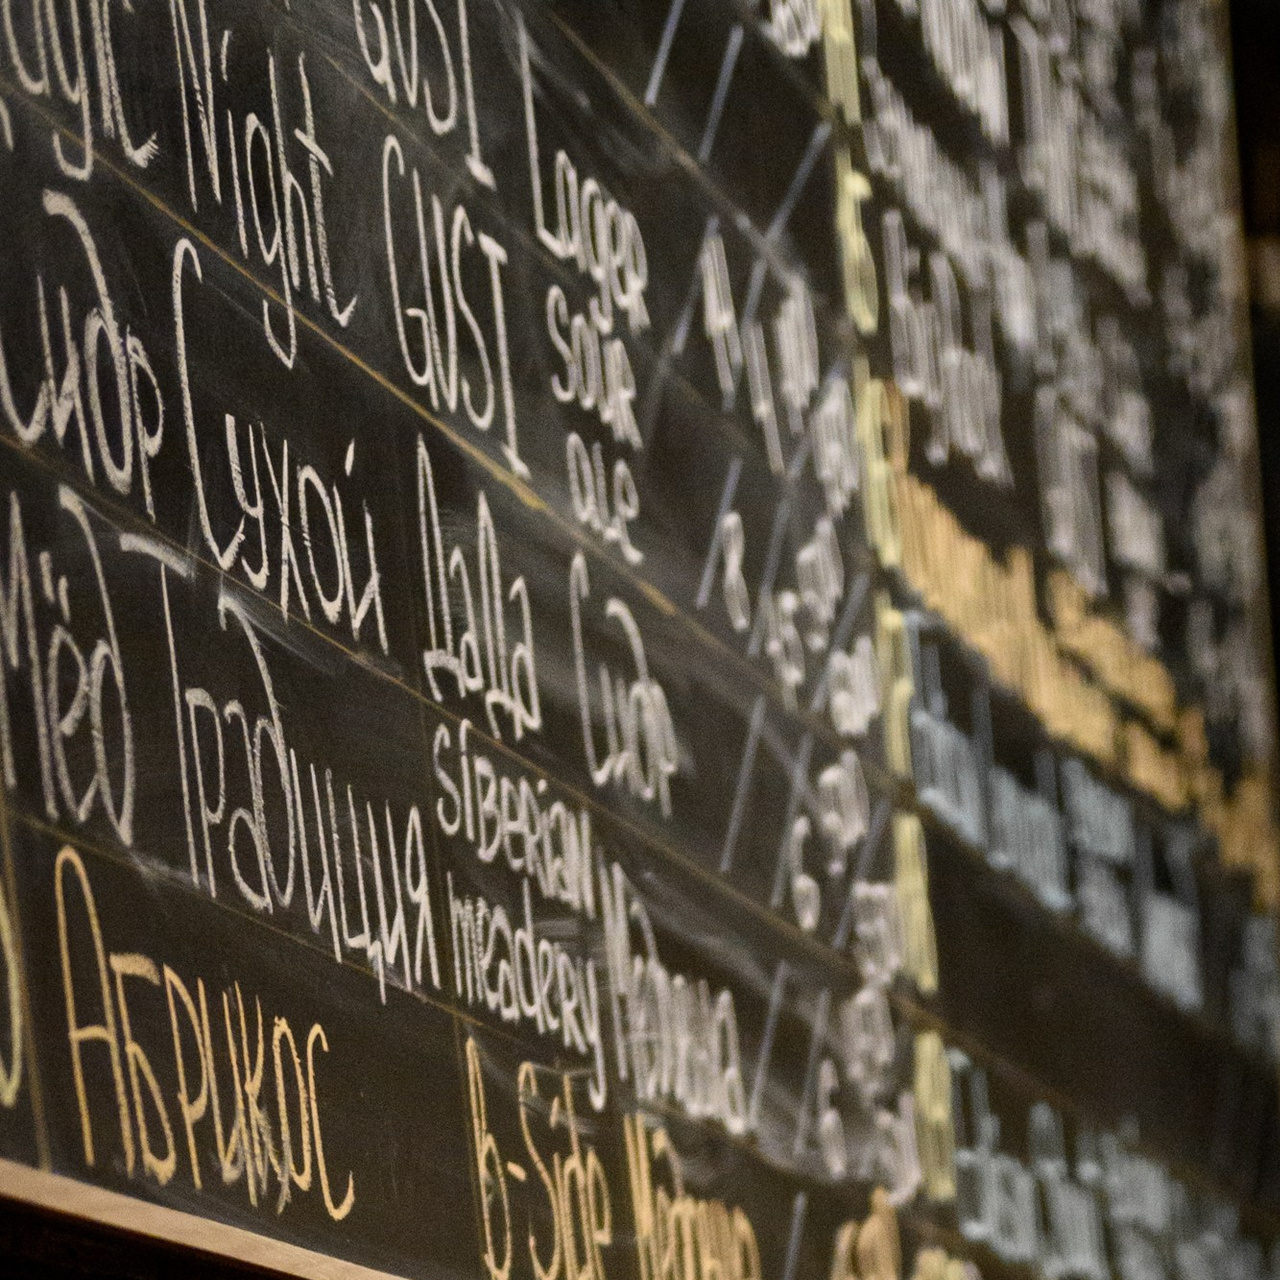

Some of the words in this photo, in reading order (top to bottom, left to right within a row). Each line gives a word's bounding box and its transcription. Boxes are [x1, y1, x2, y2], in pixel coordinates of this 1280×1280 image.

[169, 0, 356, 369] Night
[383, 135, 530, 478] GUST
[173, 238, 388, 655] Сухой
